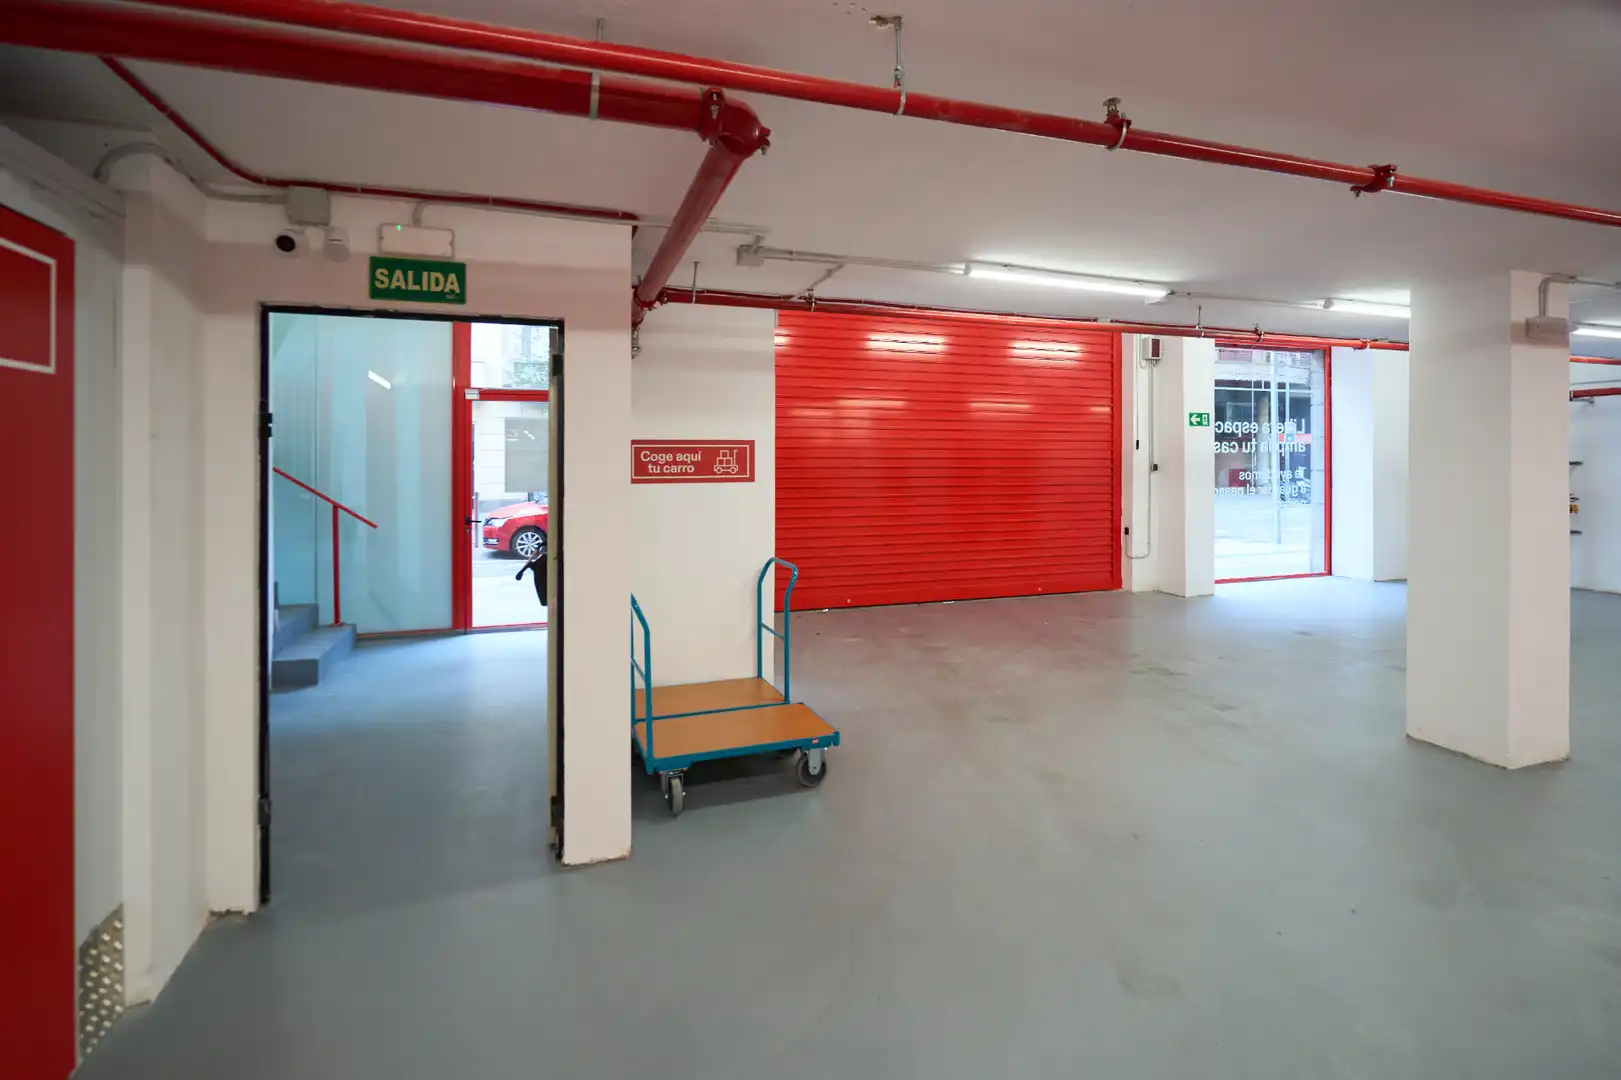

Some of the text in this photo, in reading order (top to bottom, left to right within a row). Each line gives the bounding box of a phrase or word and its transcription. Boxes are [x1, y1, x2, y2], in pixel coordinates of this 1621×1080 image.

[374, 268, 460, 293] SALIDA
[640, 450, 702, 464] Coge aquí
[647, 463, 695, 473] tu carro
